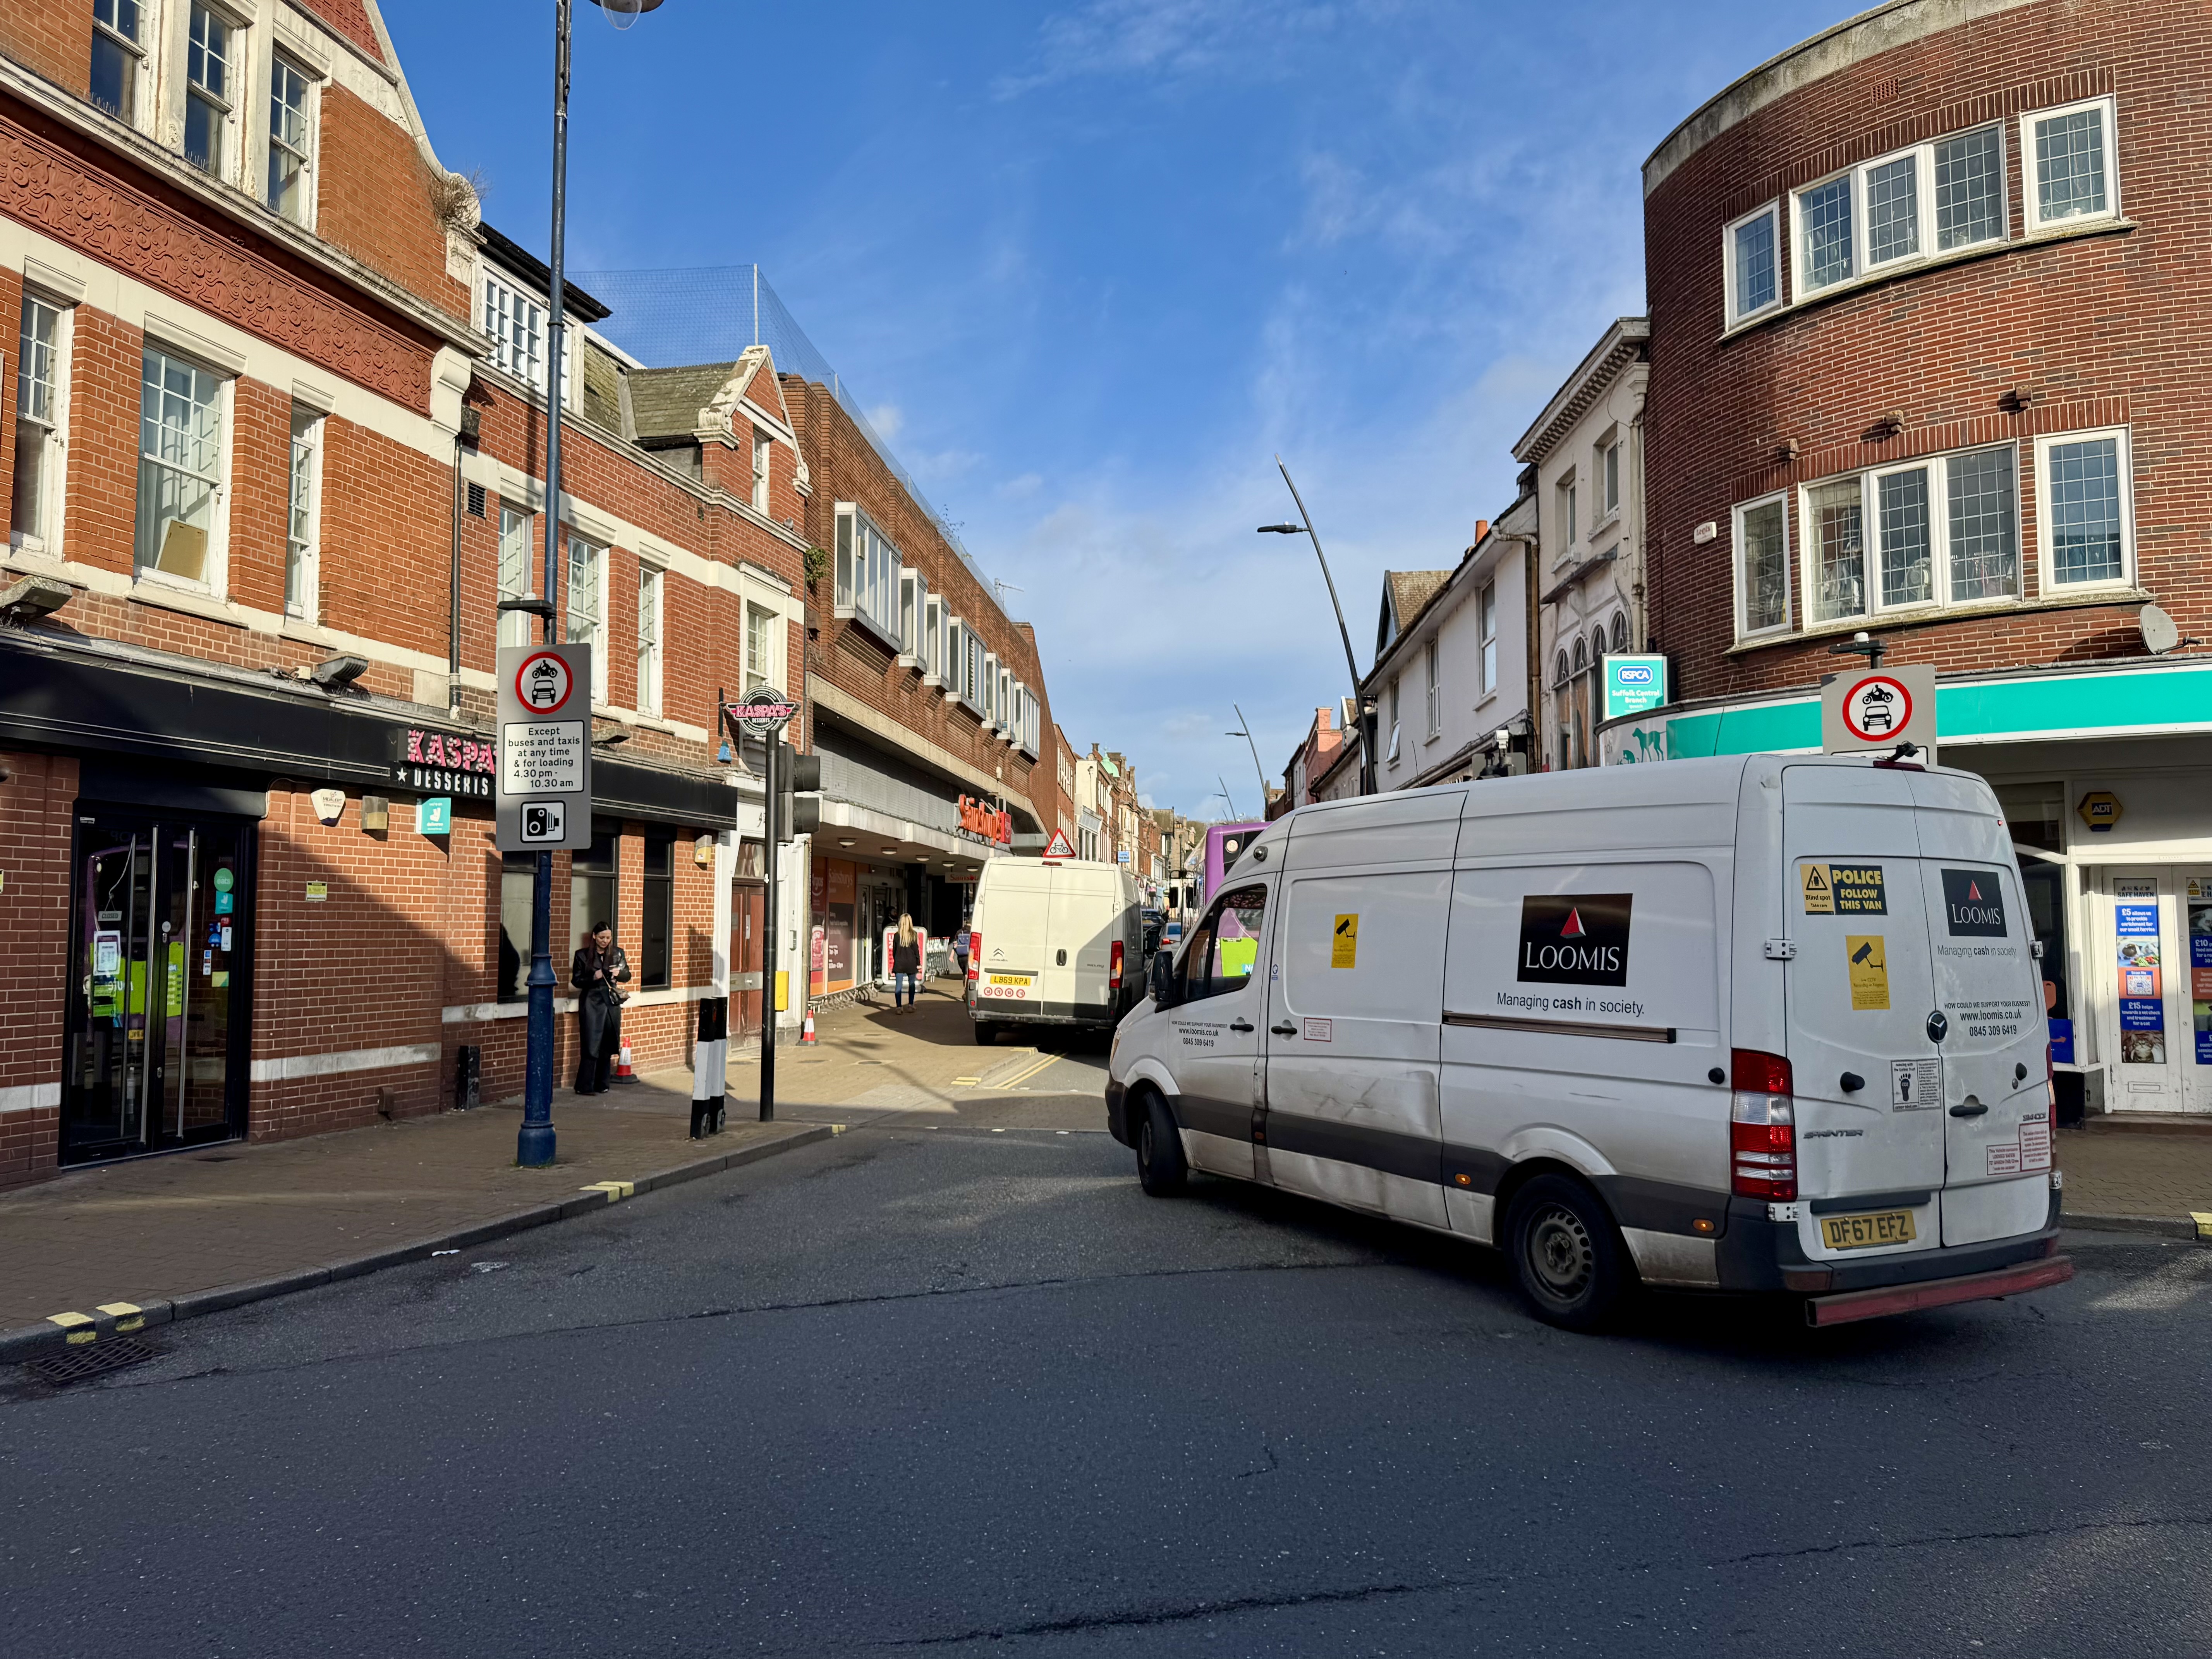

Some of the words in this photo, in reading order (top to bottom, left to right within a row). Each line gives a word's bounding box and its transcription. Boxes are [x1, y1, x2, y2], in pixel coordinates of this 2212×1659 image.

[1621, 670, 1650, 680] RSPCA
[736, 704, 787, 717] KASPA'S
[529, 726, 560, 736] Except
[538, 737, 554, 745] and
[558, 736, 580, 745] taxis
[550, 747, 570, 756] time
[540, 758, 573, 767] loading
[514, 769, 536, 778] 4.30
[414, 768, 488, 795] DESSERTS
[531, 779, 557, 788] 10.30
[2093, 804, 2112, 813] ADT
[1832, 870, 1882, 884] POLICE
[1840, 889, 1877, 898] FOLLOW
[1839, 900, 1860, 910] THIS
[1863, 901, 1882, 910] VAN
[1951, 904, 2001, 925] LOOMIS
[1937, 945, 1972, 957] Managing
[1973, 945, 1989, 955] cash
[1525, 942, 1620, 971] LOOMIS
[1014, 977, 1028, 985] KPA
[1497, 992, 1549, 1011] Managing
[1553, 997, 1581, 1010] cash
[1586, 998, 1595, 1011] in
[1600, 1000, 1644, 1017] society.
[1960, 1009, 2021, 1021] www.loomis.co.uk
[1179, 1027, 1219, 1036] www.loomis.co.uk
[1970, 1026, 1987, 1036] 0845
[1989, 1025, 2000, 1036] 309
[2002, 1025, 2017, 1035] 6419
[1803, 1129, 1864, 1139] SPRINTER
[1829, 1218, 1872, 1243] DF67
[1877, 1215, 1908, 1238] EFZ
